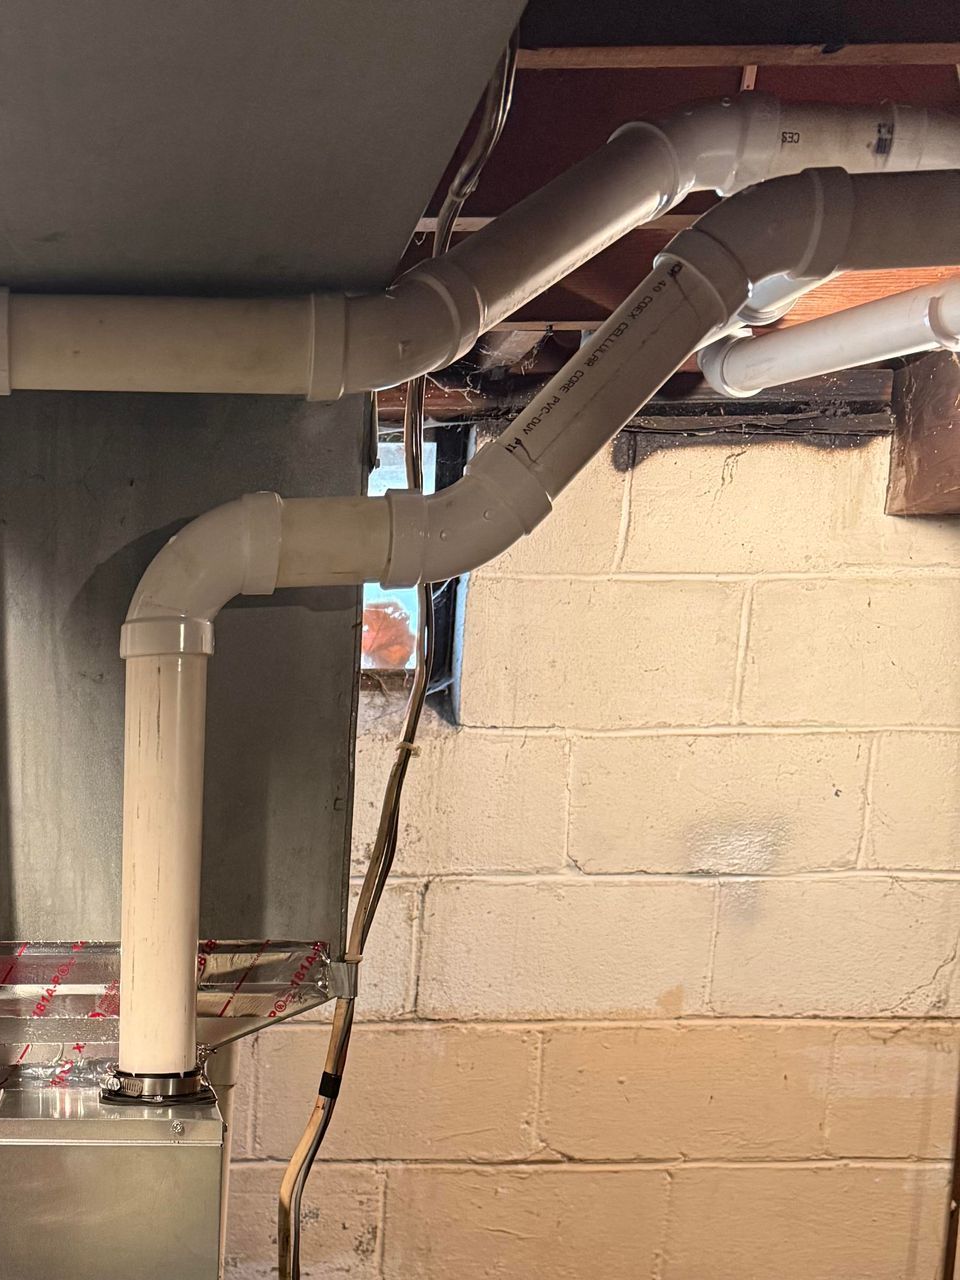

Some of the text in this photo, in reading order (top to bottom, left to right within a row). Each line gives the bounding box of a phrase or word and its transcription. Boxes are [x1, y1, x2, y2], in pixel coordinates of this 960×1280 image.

[652, 280, 666, 292] 40
[627, 296, 653, 320] COEX
[584, 321, 629, 367] CELLULAR
[560, 370, 584, 393] CORE
